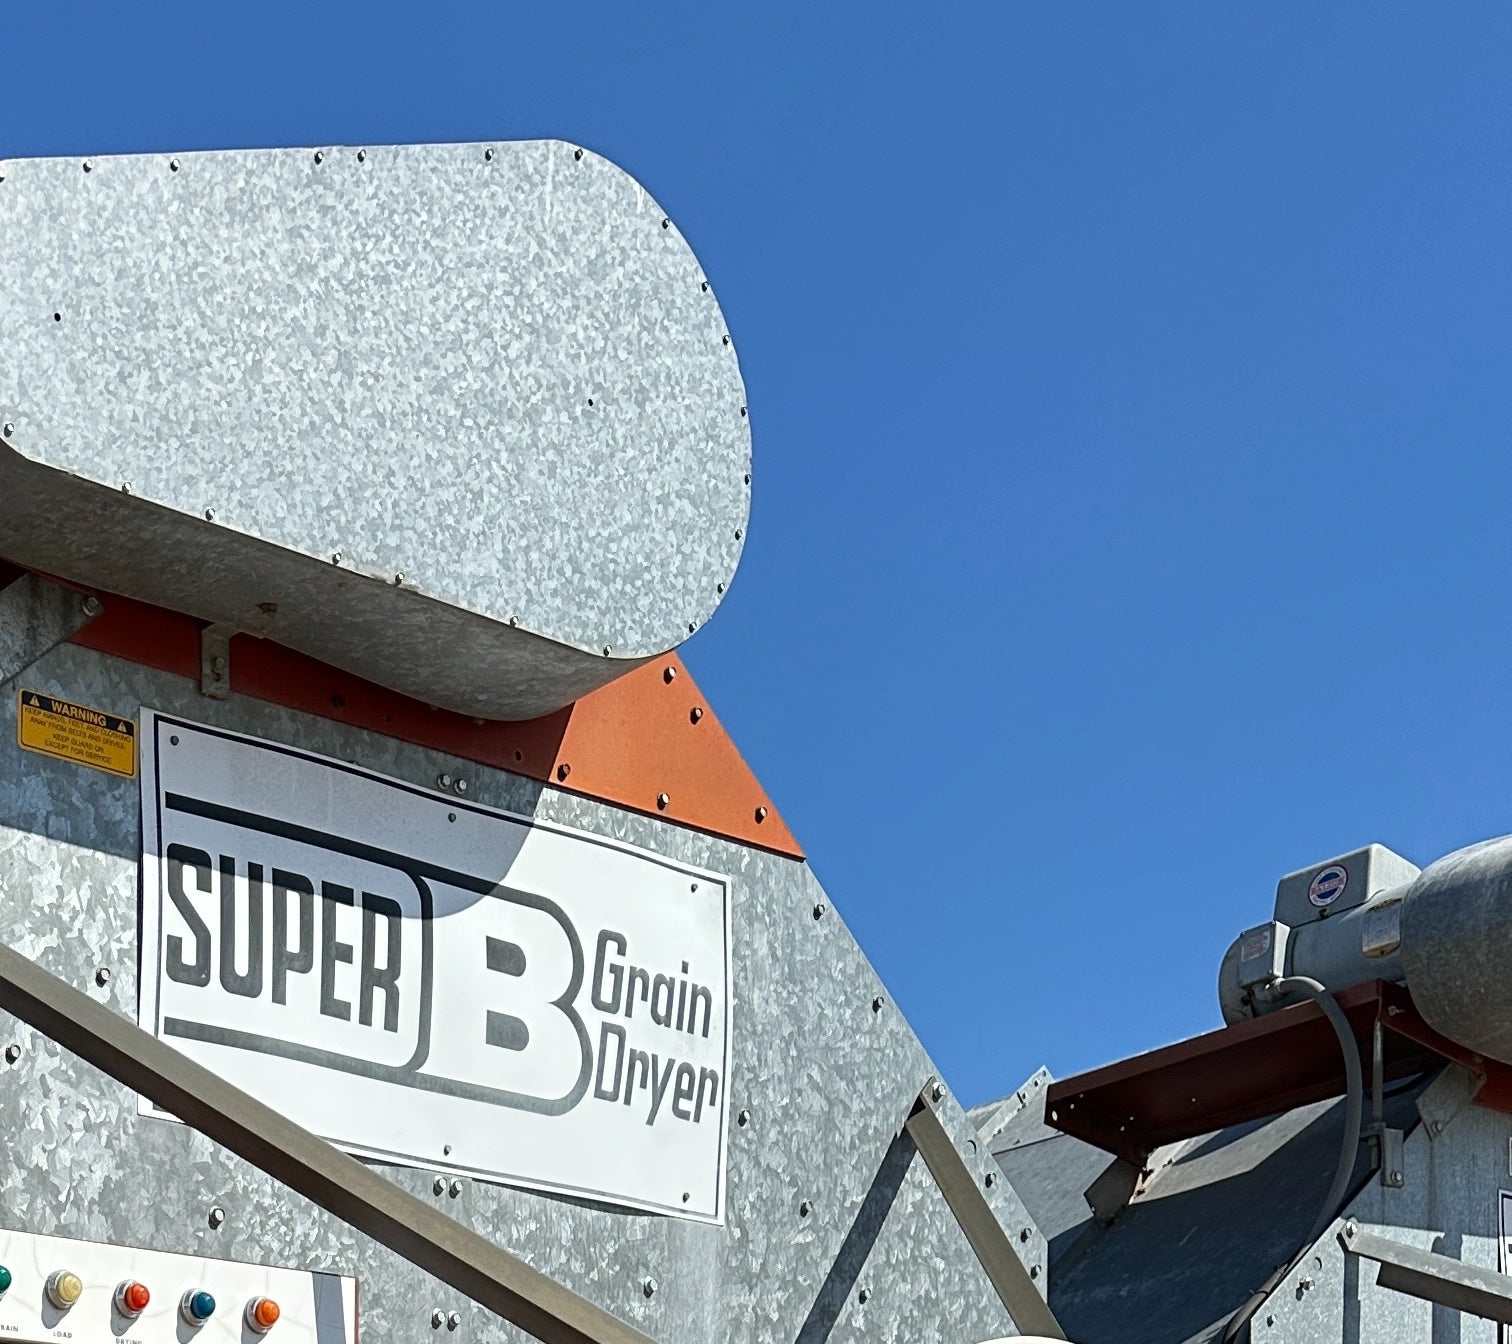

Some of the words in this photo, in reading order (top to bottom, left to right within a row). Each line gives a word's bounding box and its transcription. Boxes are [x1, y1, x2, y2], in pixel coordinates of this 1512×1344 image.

[51, 700, 107, 727] WARNING
[48, 721, 67, 732] FROM
[68, 728, 87, 738] BELTS
[88, 733, 102, 742] AND
[53, 733, 69, 743] KEEP
[71, 738, 94, 750] GUARD
[94, 745, 104, 753] ON
[45, 740, 68, 750] EXCEPT
[71, 746, 84, 756] FOR
[166, 843, 402, 1032] SUPER
[592, 929, 713, 1038] Grain
[594, 1022, 718, 1126] Dryer
[53, 1331, 72, 1339] LOAD
